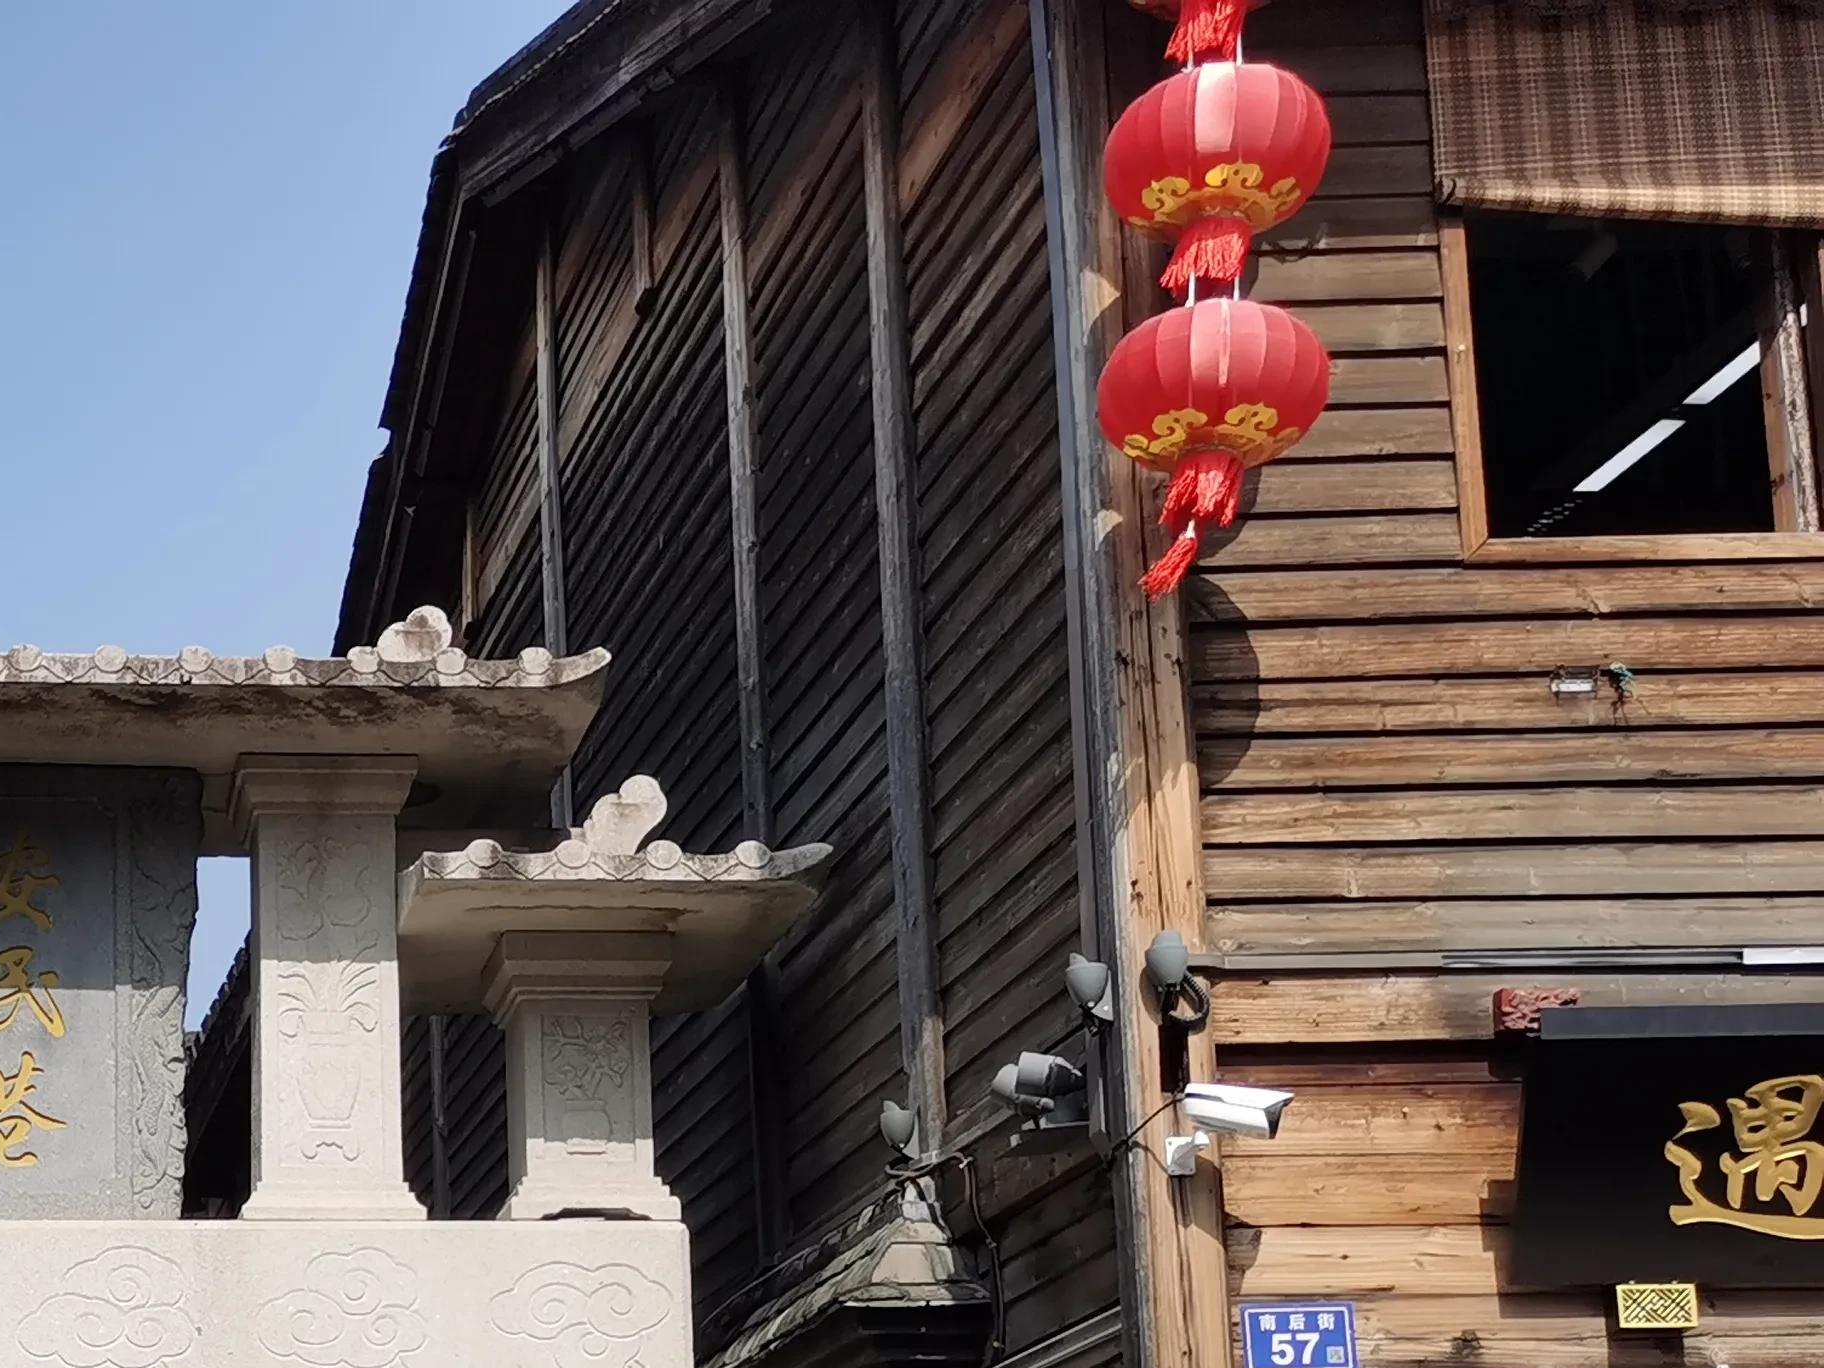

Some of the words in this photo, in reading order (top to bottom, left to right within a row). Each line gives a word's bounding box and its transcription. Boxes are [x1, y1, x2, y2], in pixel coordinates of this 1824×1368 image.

[1258, 1313, 1335, 1332] 南后街
[1270, 1332, 1320, 1366] 57
